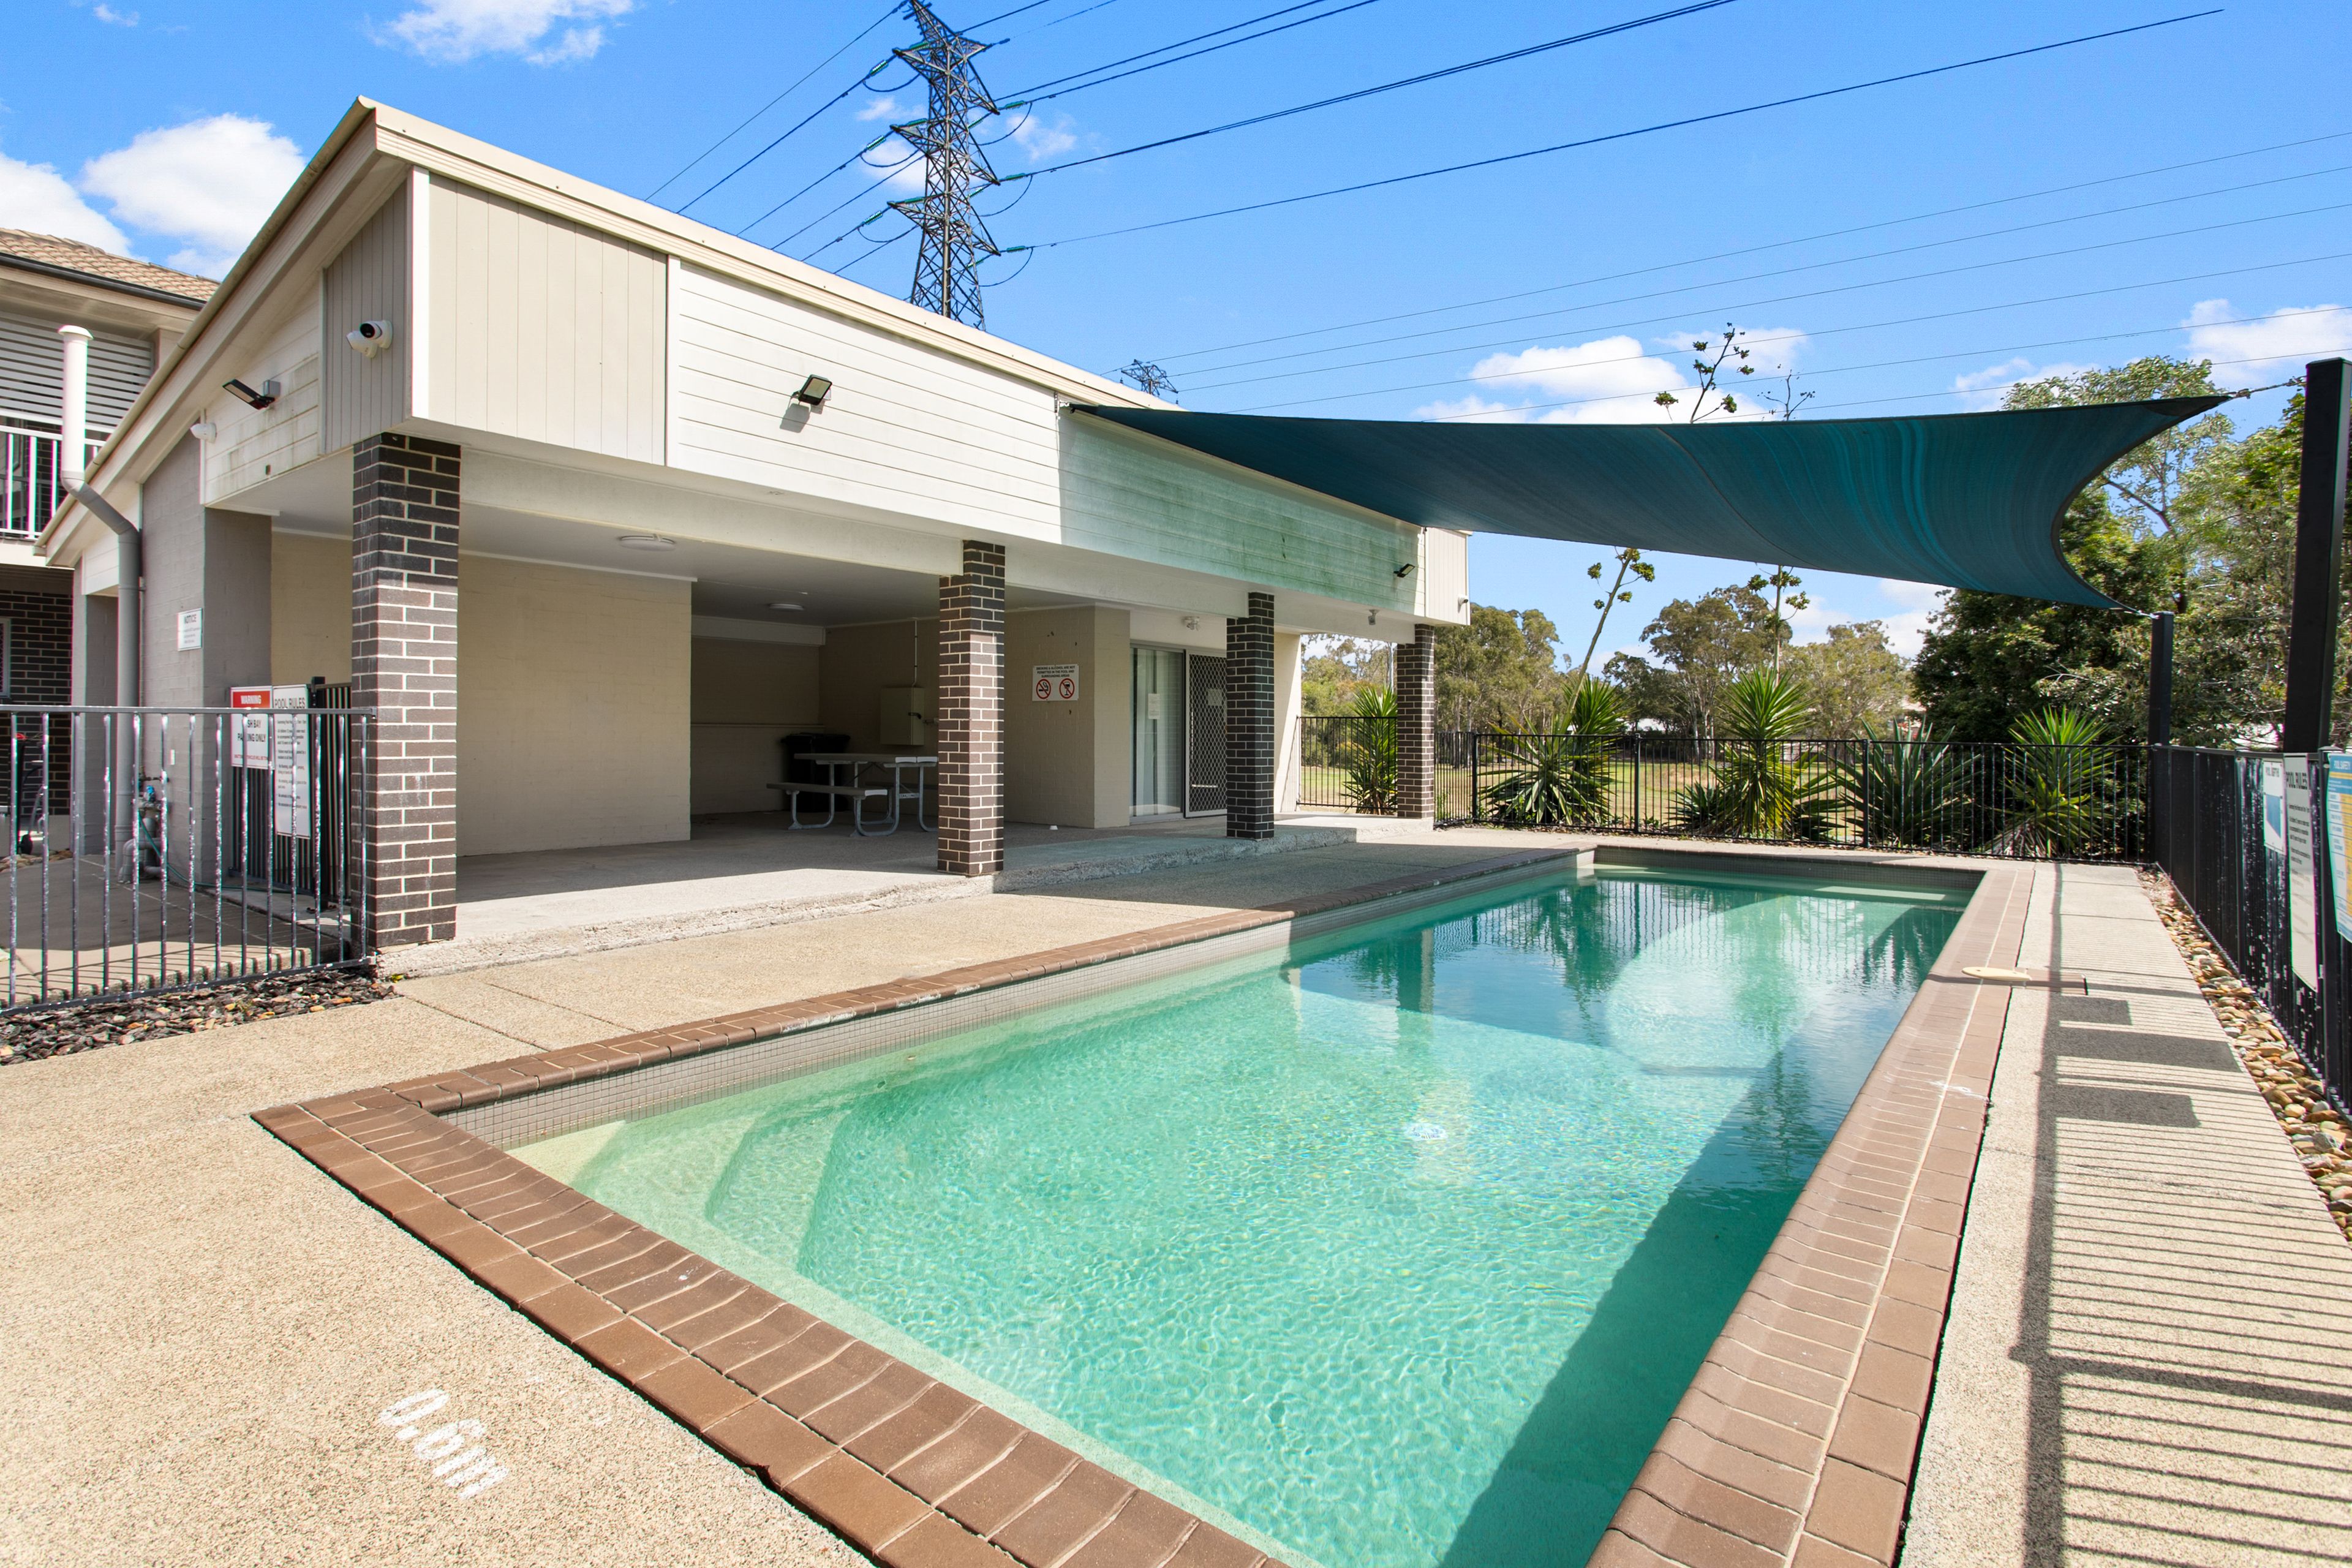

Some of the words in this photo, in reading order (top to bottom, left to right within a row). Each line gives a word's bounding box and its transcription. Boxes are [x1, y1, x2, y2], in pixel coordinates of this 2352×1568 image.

[241, 695, 262, 704] WARNING
[274, 698, 288, 709] POOL
[289, 697, 306, 709] RULES
[2285, 772, 2295, 788] POOL
[2296, 772, 2307, 790] RULES
[378, 1387, 510, 1500] 0.6m
